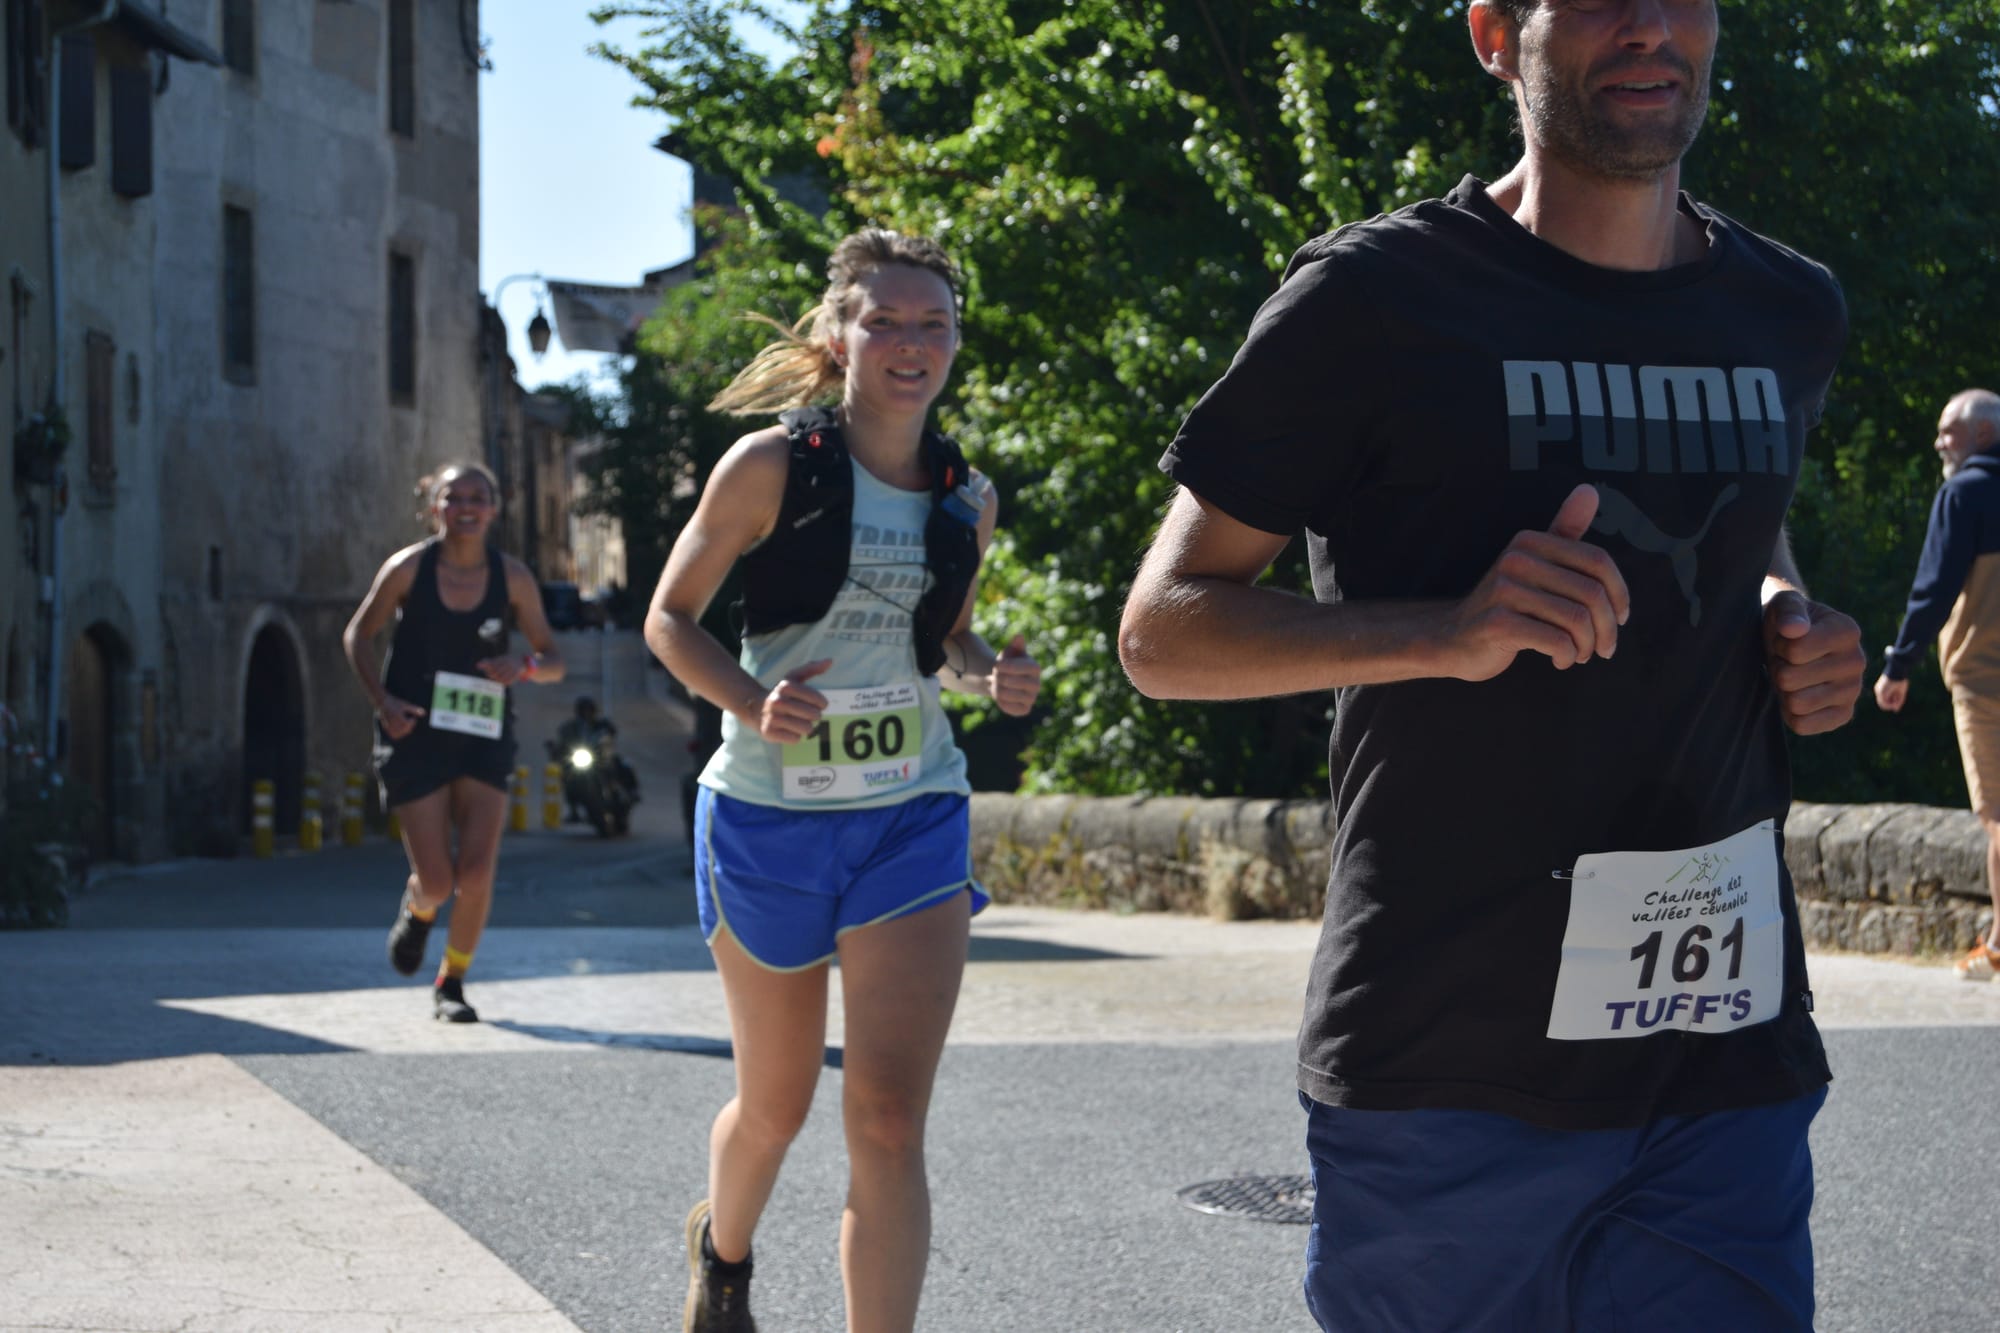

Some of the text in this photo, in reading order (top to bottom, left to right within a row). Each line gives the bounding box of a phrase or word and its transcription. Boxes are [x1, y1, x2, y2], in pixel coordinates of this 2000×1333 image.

[1502, 360, 1789, 475] PUMA
[446, 690, 494, 717] 118
[807, 715, 904, 762] 160
[1632, 892, 1748, 922] vallées cévenoles
[1644, 875, 1742, 905] Challenge des
[1630, 916, 1744, 989] 161
[1605, 989, 1752, 1031] TUFF'S
